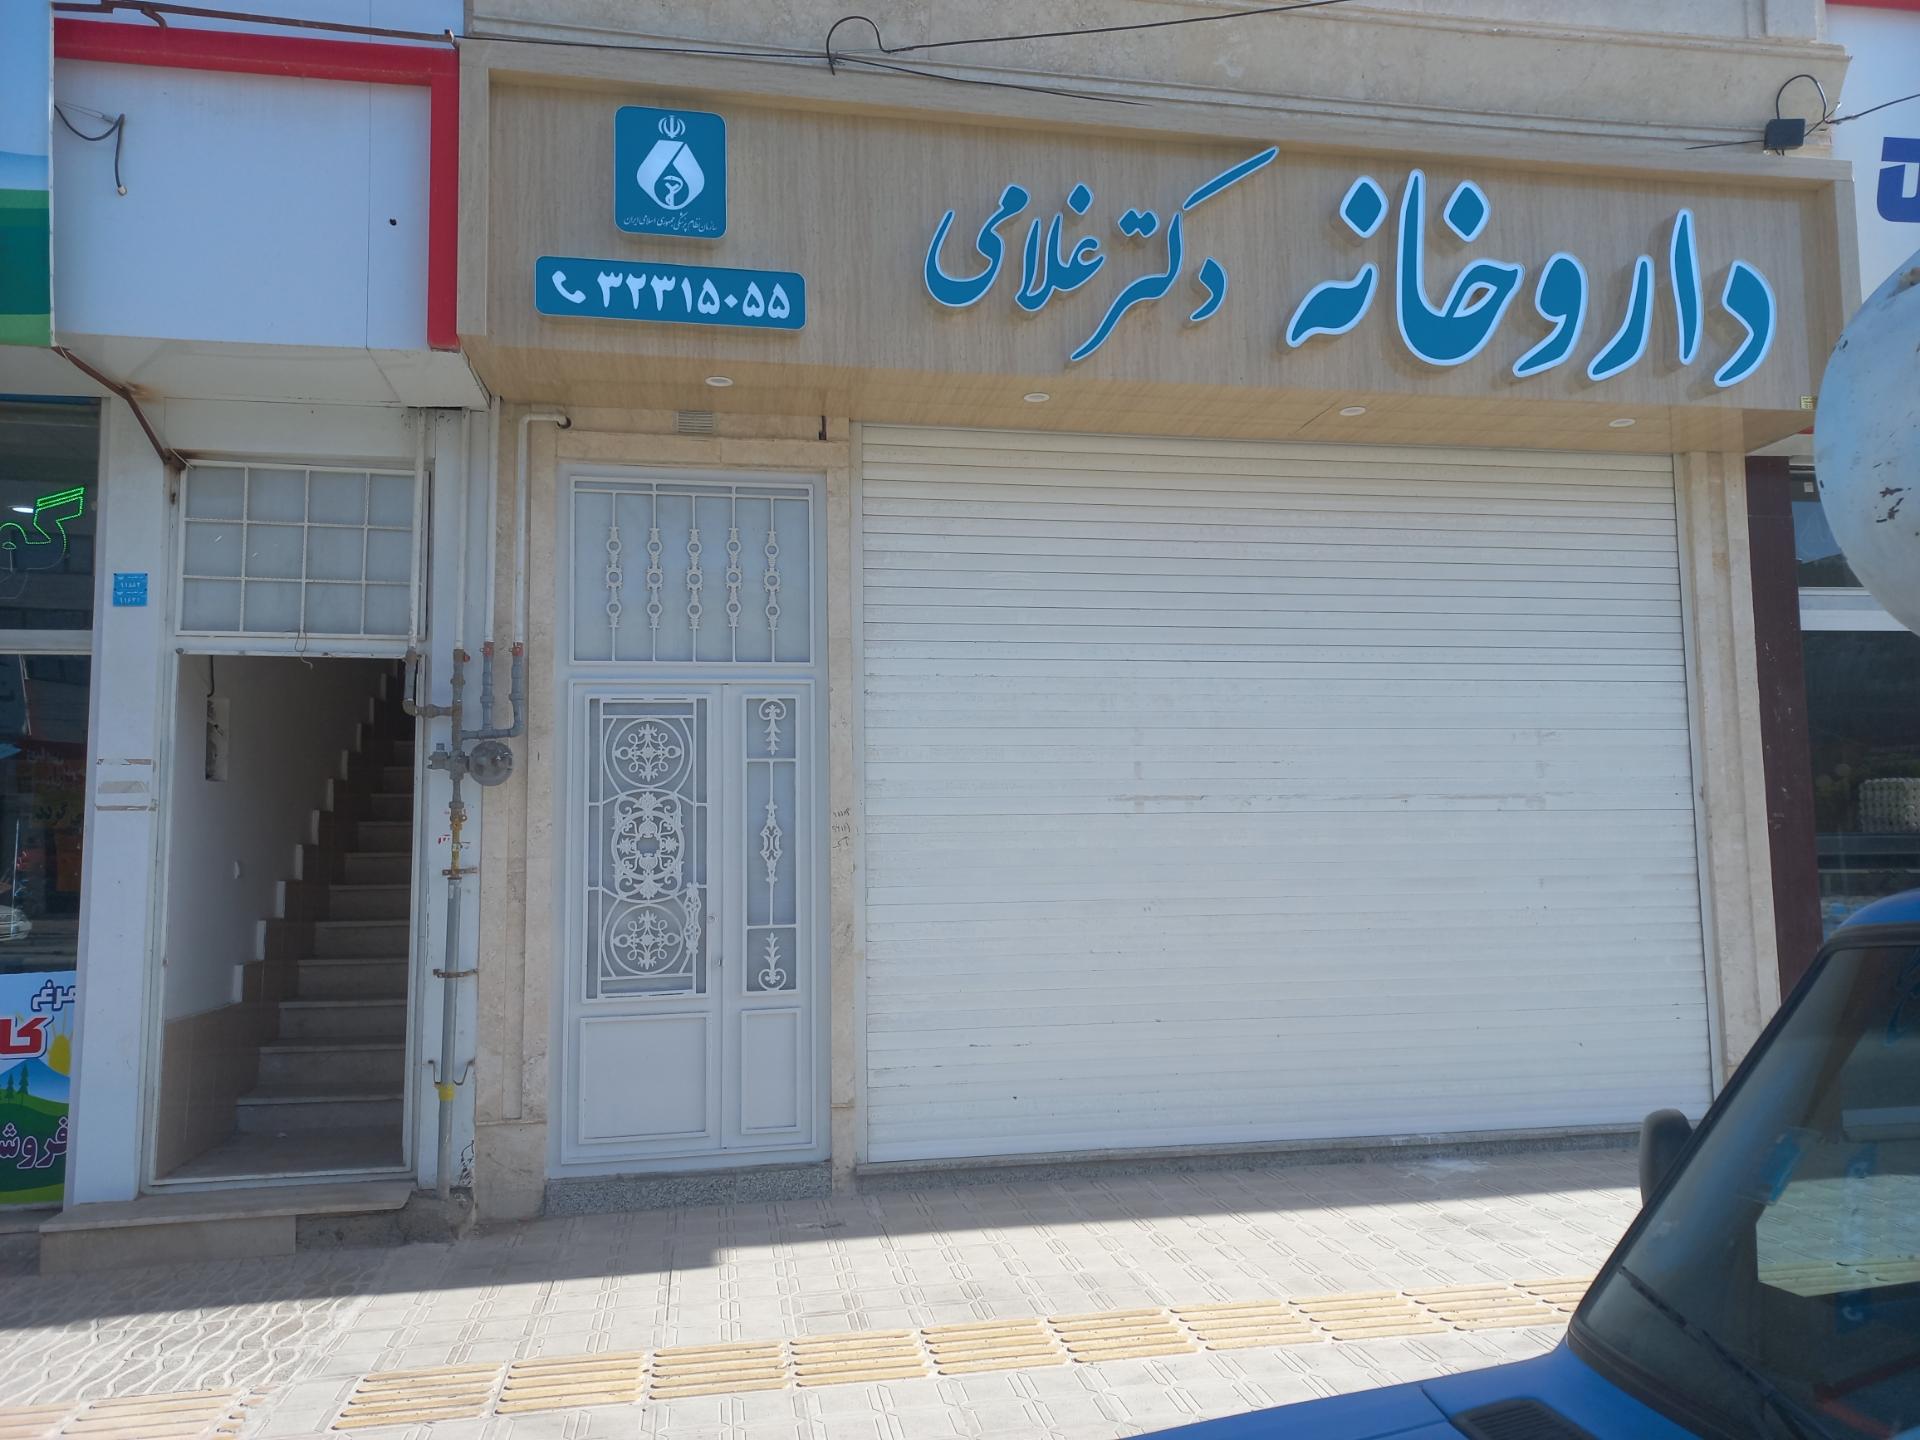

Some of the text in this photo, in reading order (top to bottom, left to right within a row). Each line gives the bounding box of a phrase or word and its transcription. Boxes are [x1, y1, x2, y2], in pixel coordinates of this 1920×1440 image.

[623, 216, 640, 226] ایران
[640, 214, 657, 226] اسلامی
[656, 216, 676, 228] جمهوری
[687, 216, 701, 230] نظام
[924, 183, 1106, 312] غلامی
[1070, 145, 1280, 361] دکتر
[1286, 169, 1777, 388] داروخانه
[596, 271, 790, 319] ۳۲۳۱۵۰۵۵
